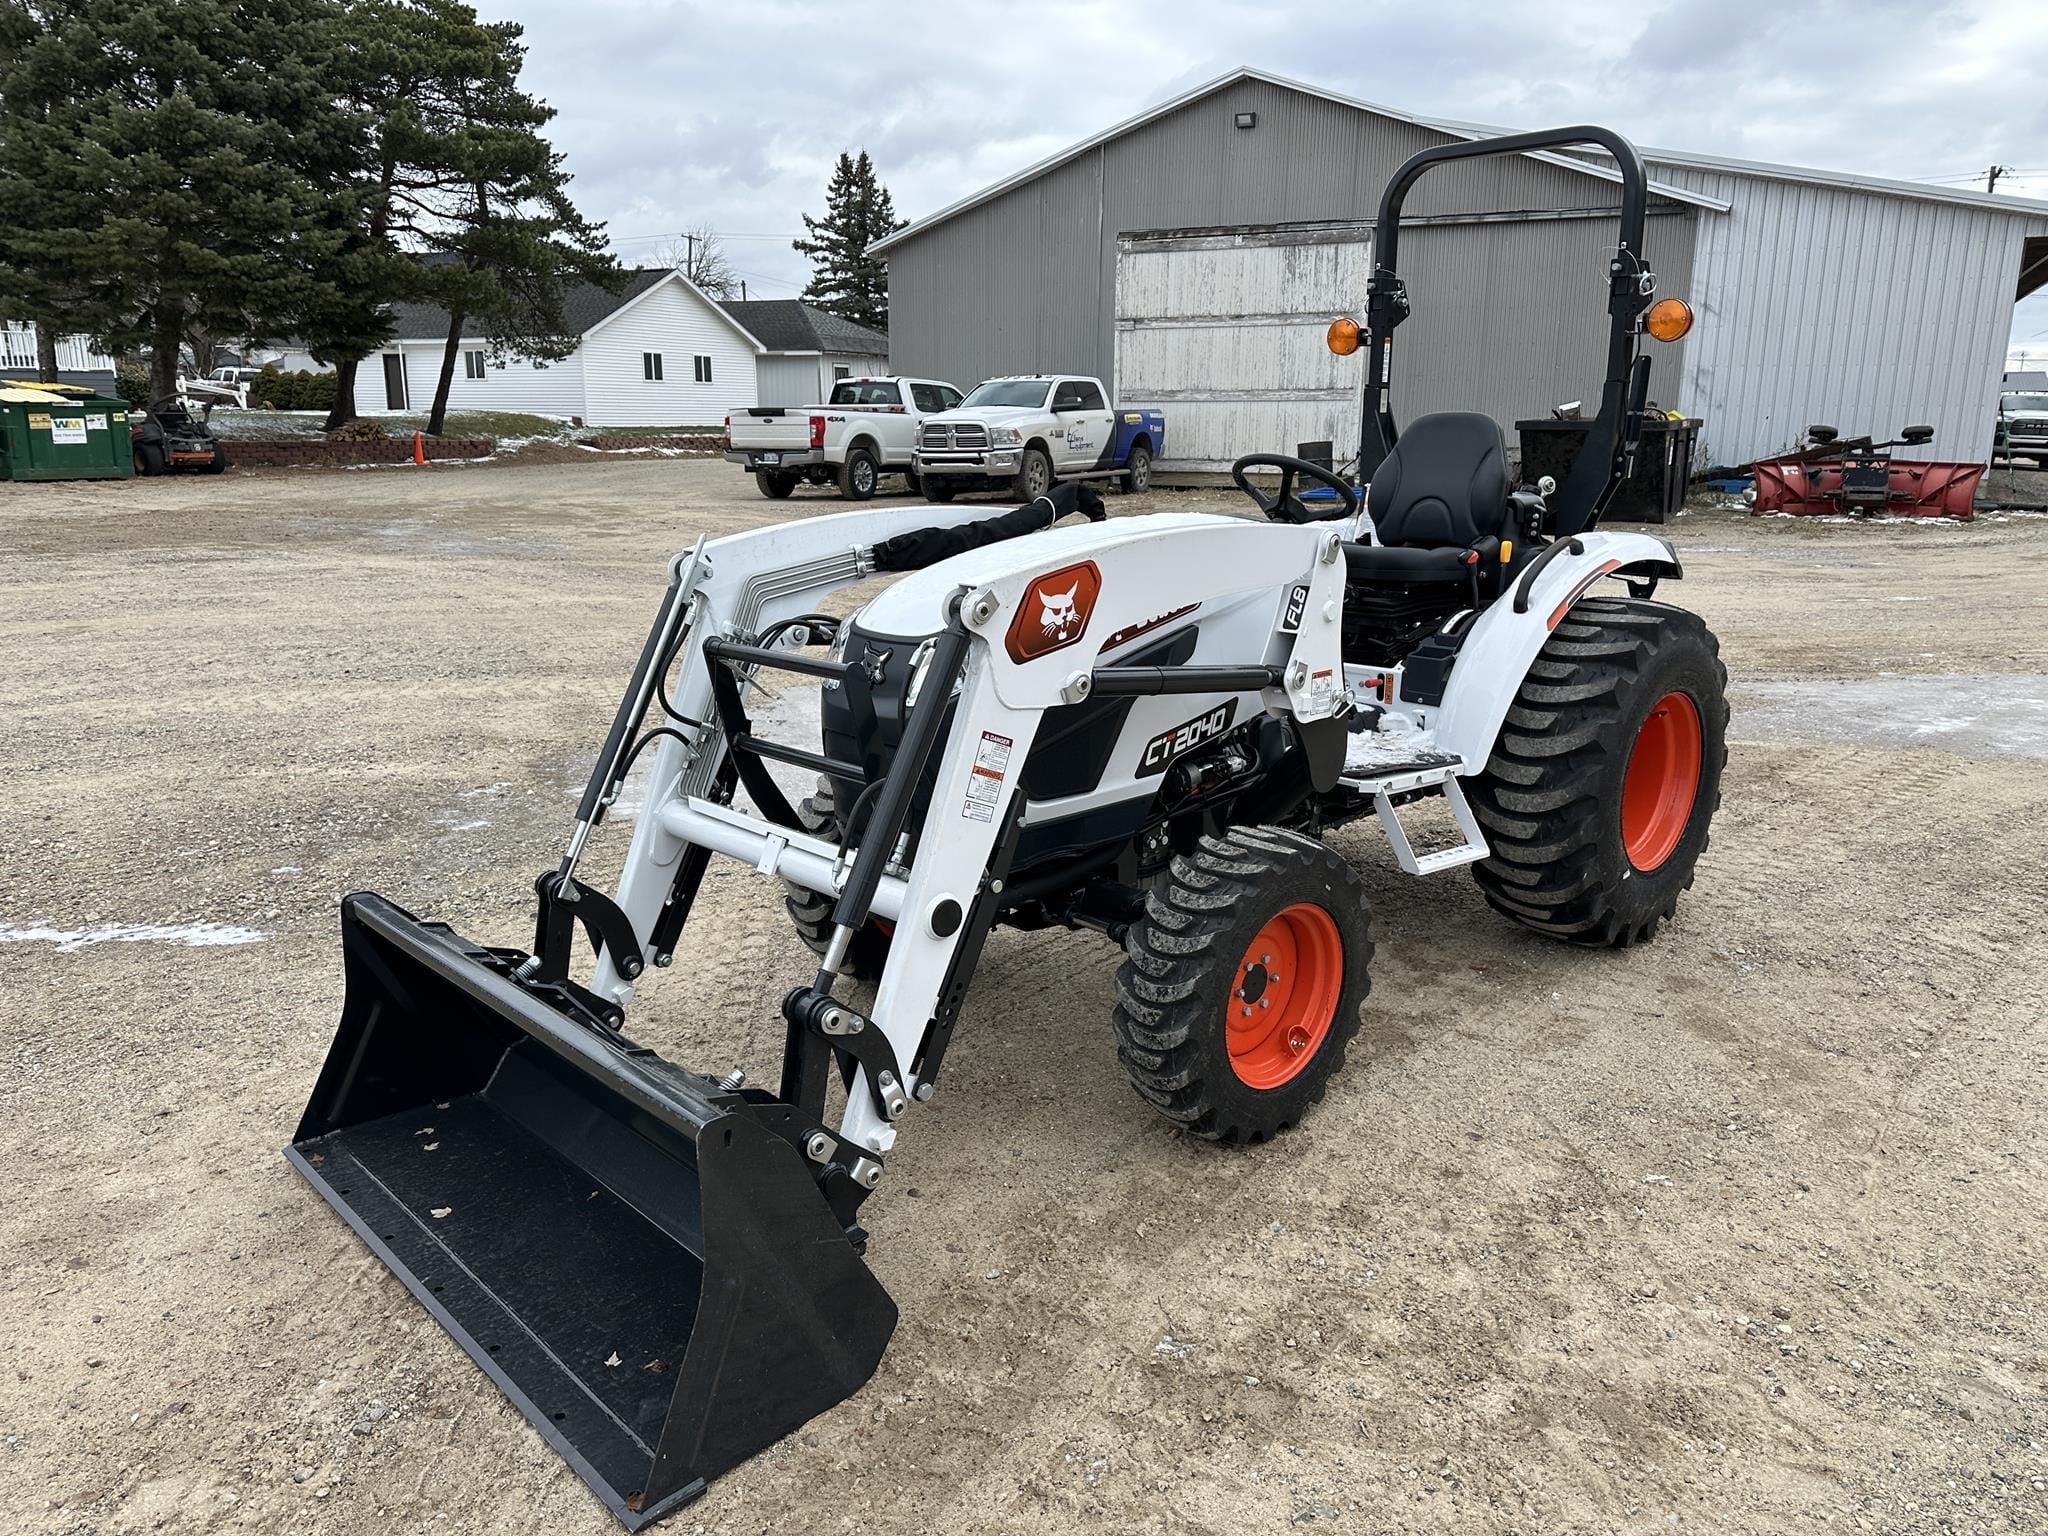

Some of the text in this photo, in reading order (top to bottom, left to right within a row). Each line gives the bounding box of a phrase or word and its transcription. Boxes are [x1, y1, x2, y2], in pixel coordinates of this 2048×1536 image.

[54, 420, 81, 428] WM
[1287, 587, 1307, 626] FL8
[990, 734, 1010, 746] DANGER
[1145, 708, 1226, 766] CT2040
